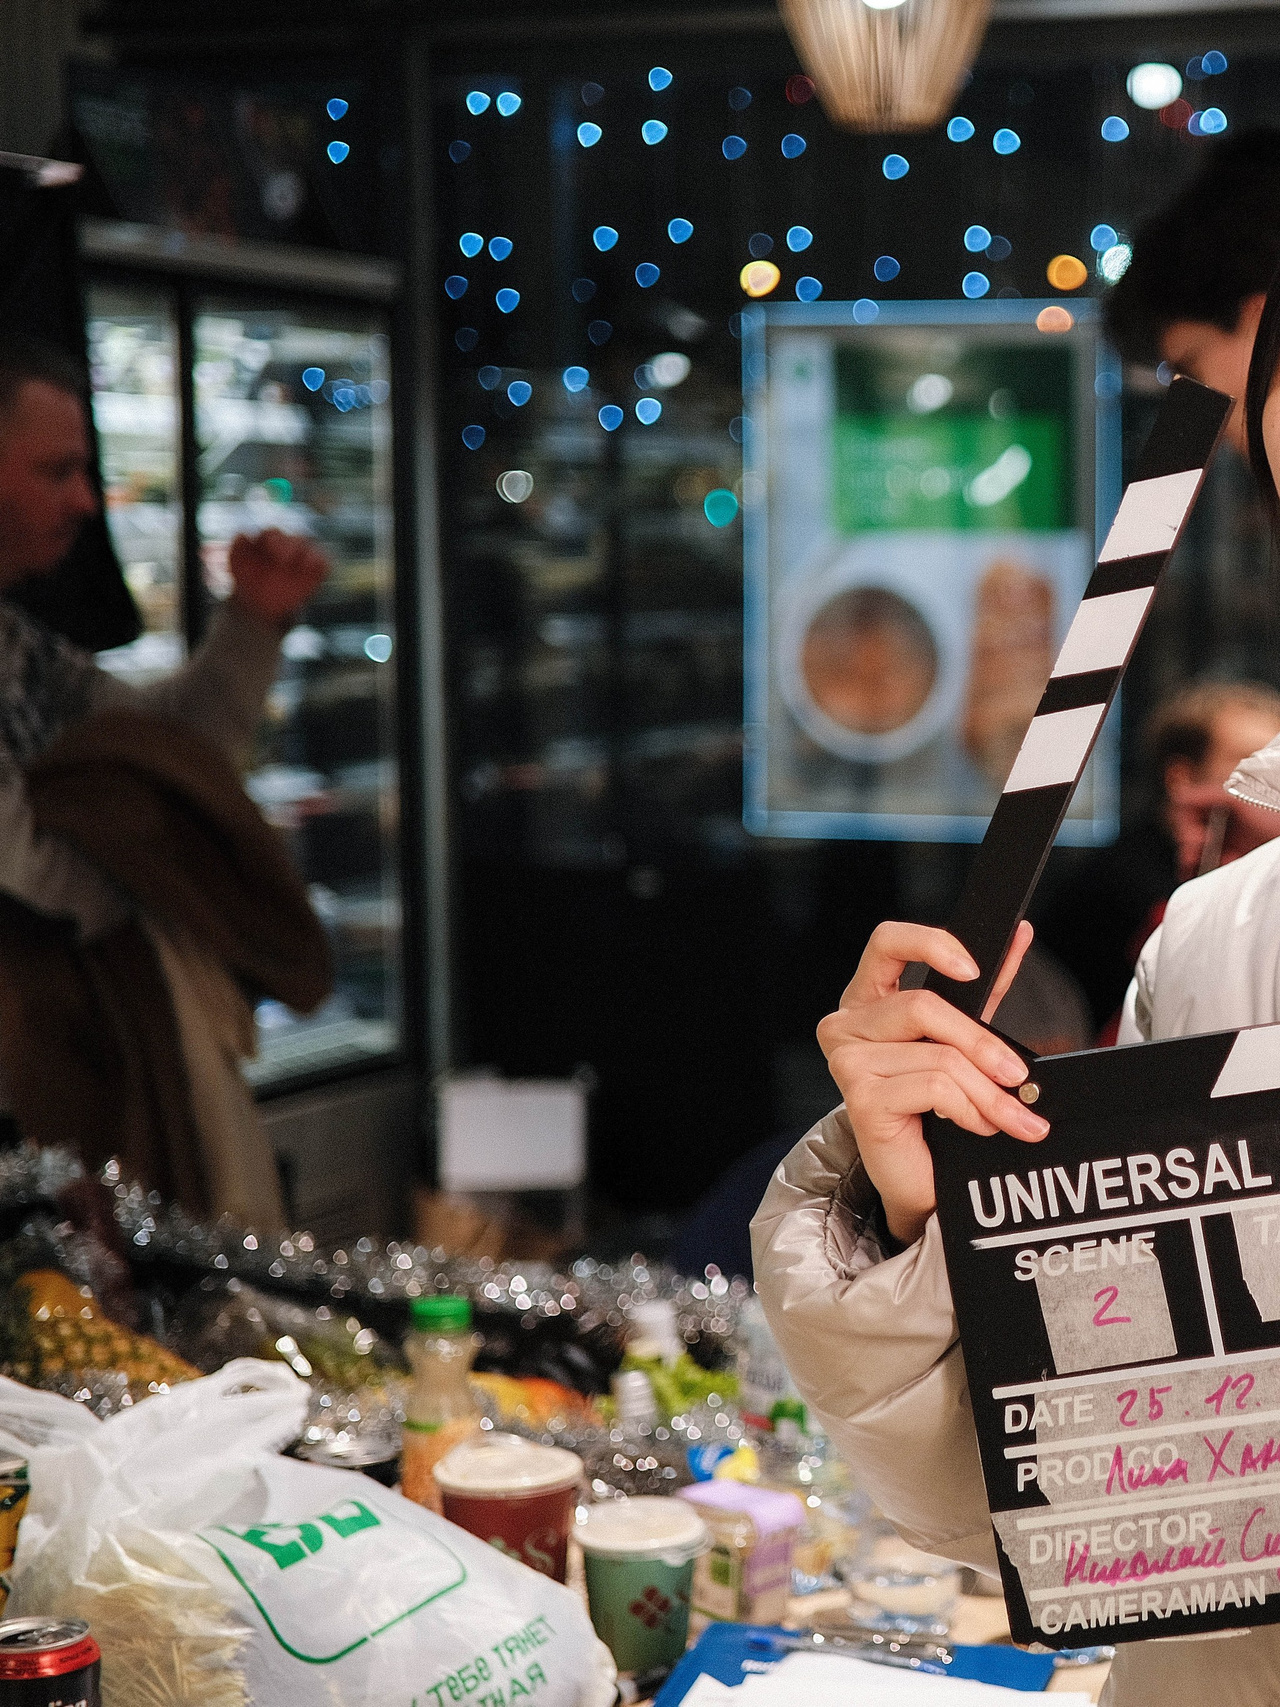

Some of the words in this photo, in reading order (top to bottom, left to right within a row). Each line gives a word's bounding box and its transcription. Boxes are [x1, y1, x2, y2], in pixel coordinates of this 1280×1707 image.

[968, 1139, 1272, 1229] UNIVERSAL
[1014, 1231, 1155, 1281] SCENE
[1092, 1285, 1132, 1327] 2
[1004, 1393, 1095, 1434] DATE
[1028, 1511, 1213, 1565] DIRECTOR
[1039, 1575, 1266, 1635] CAMERAMAN
